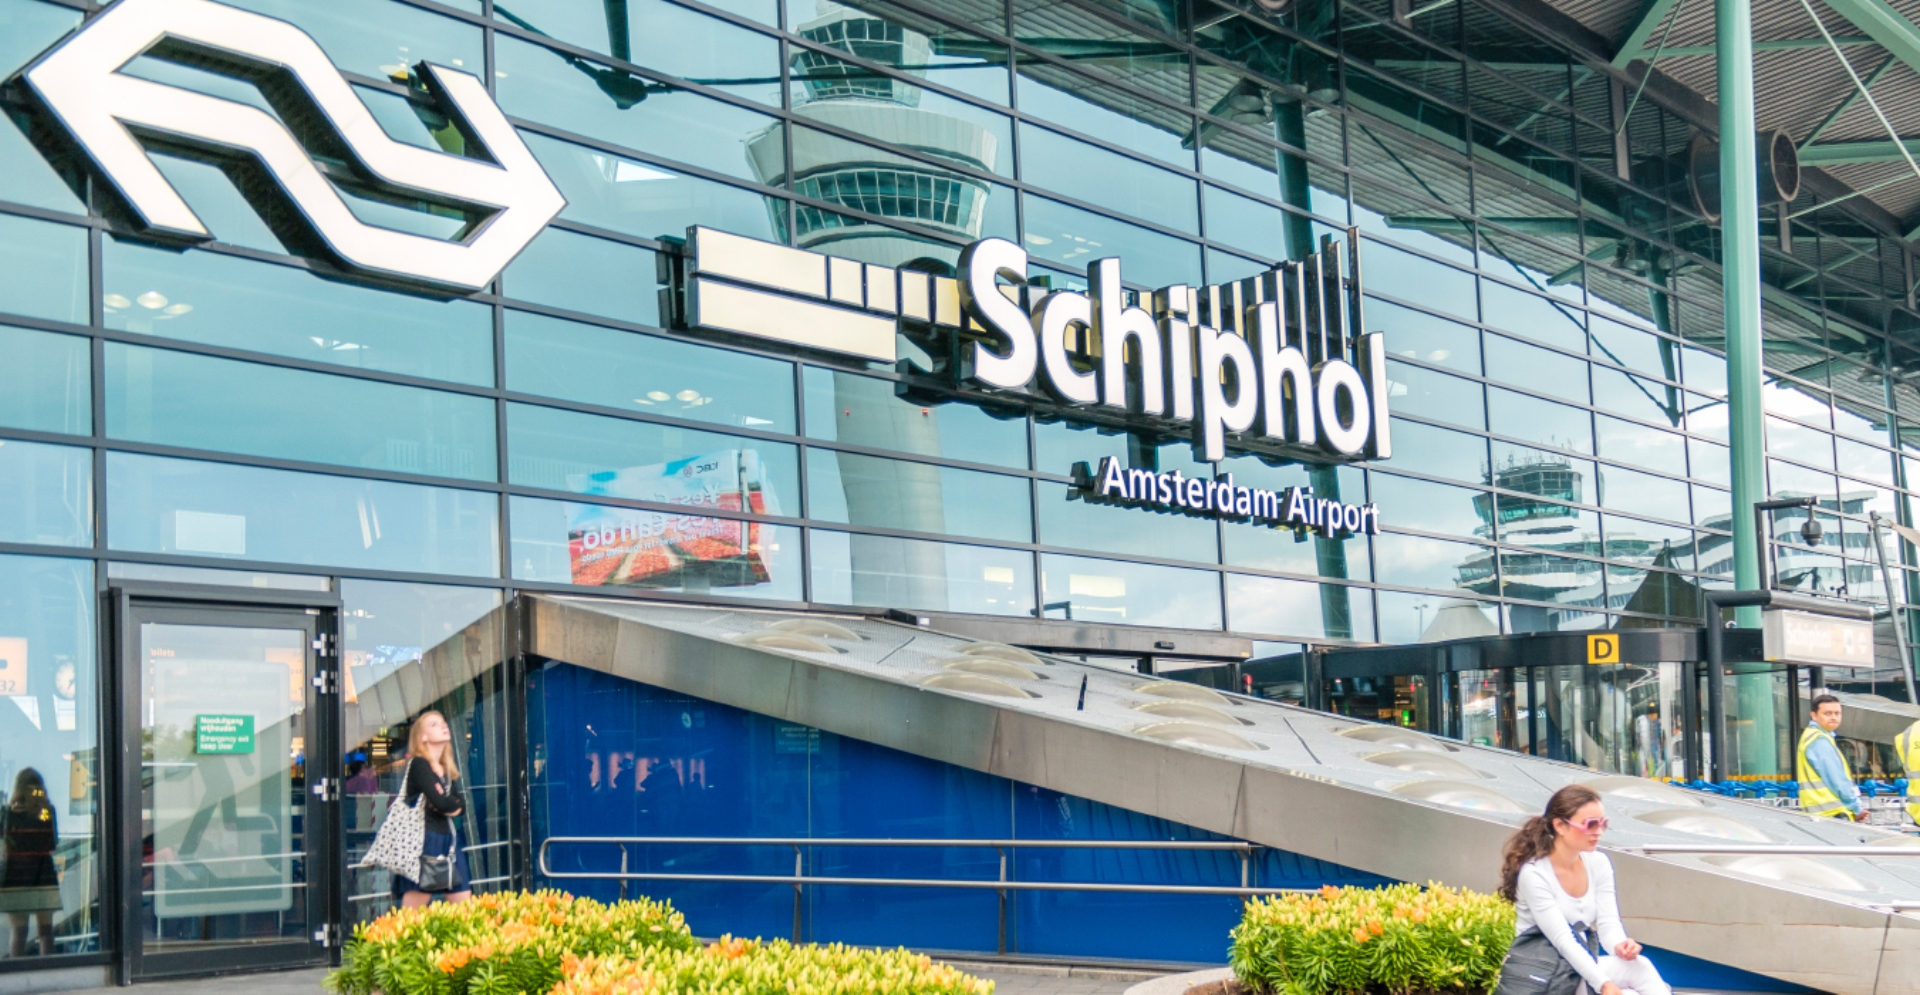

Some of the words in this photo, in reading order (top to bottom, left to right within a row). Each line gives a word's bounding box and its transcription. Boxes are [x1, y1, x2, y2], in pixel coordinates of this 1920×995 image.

[962, 236, 1393, 462] Schiphol
[1102, 455, 1279, 519] Amsterdam
[1287, 485, 1381, 538] Airport
[1594, 638, 1612, 659] D
[200, 735, 237, 744] Emergency
